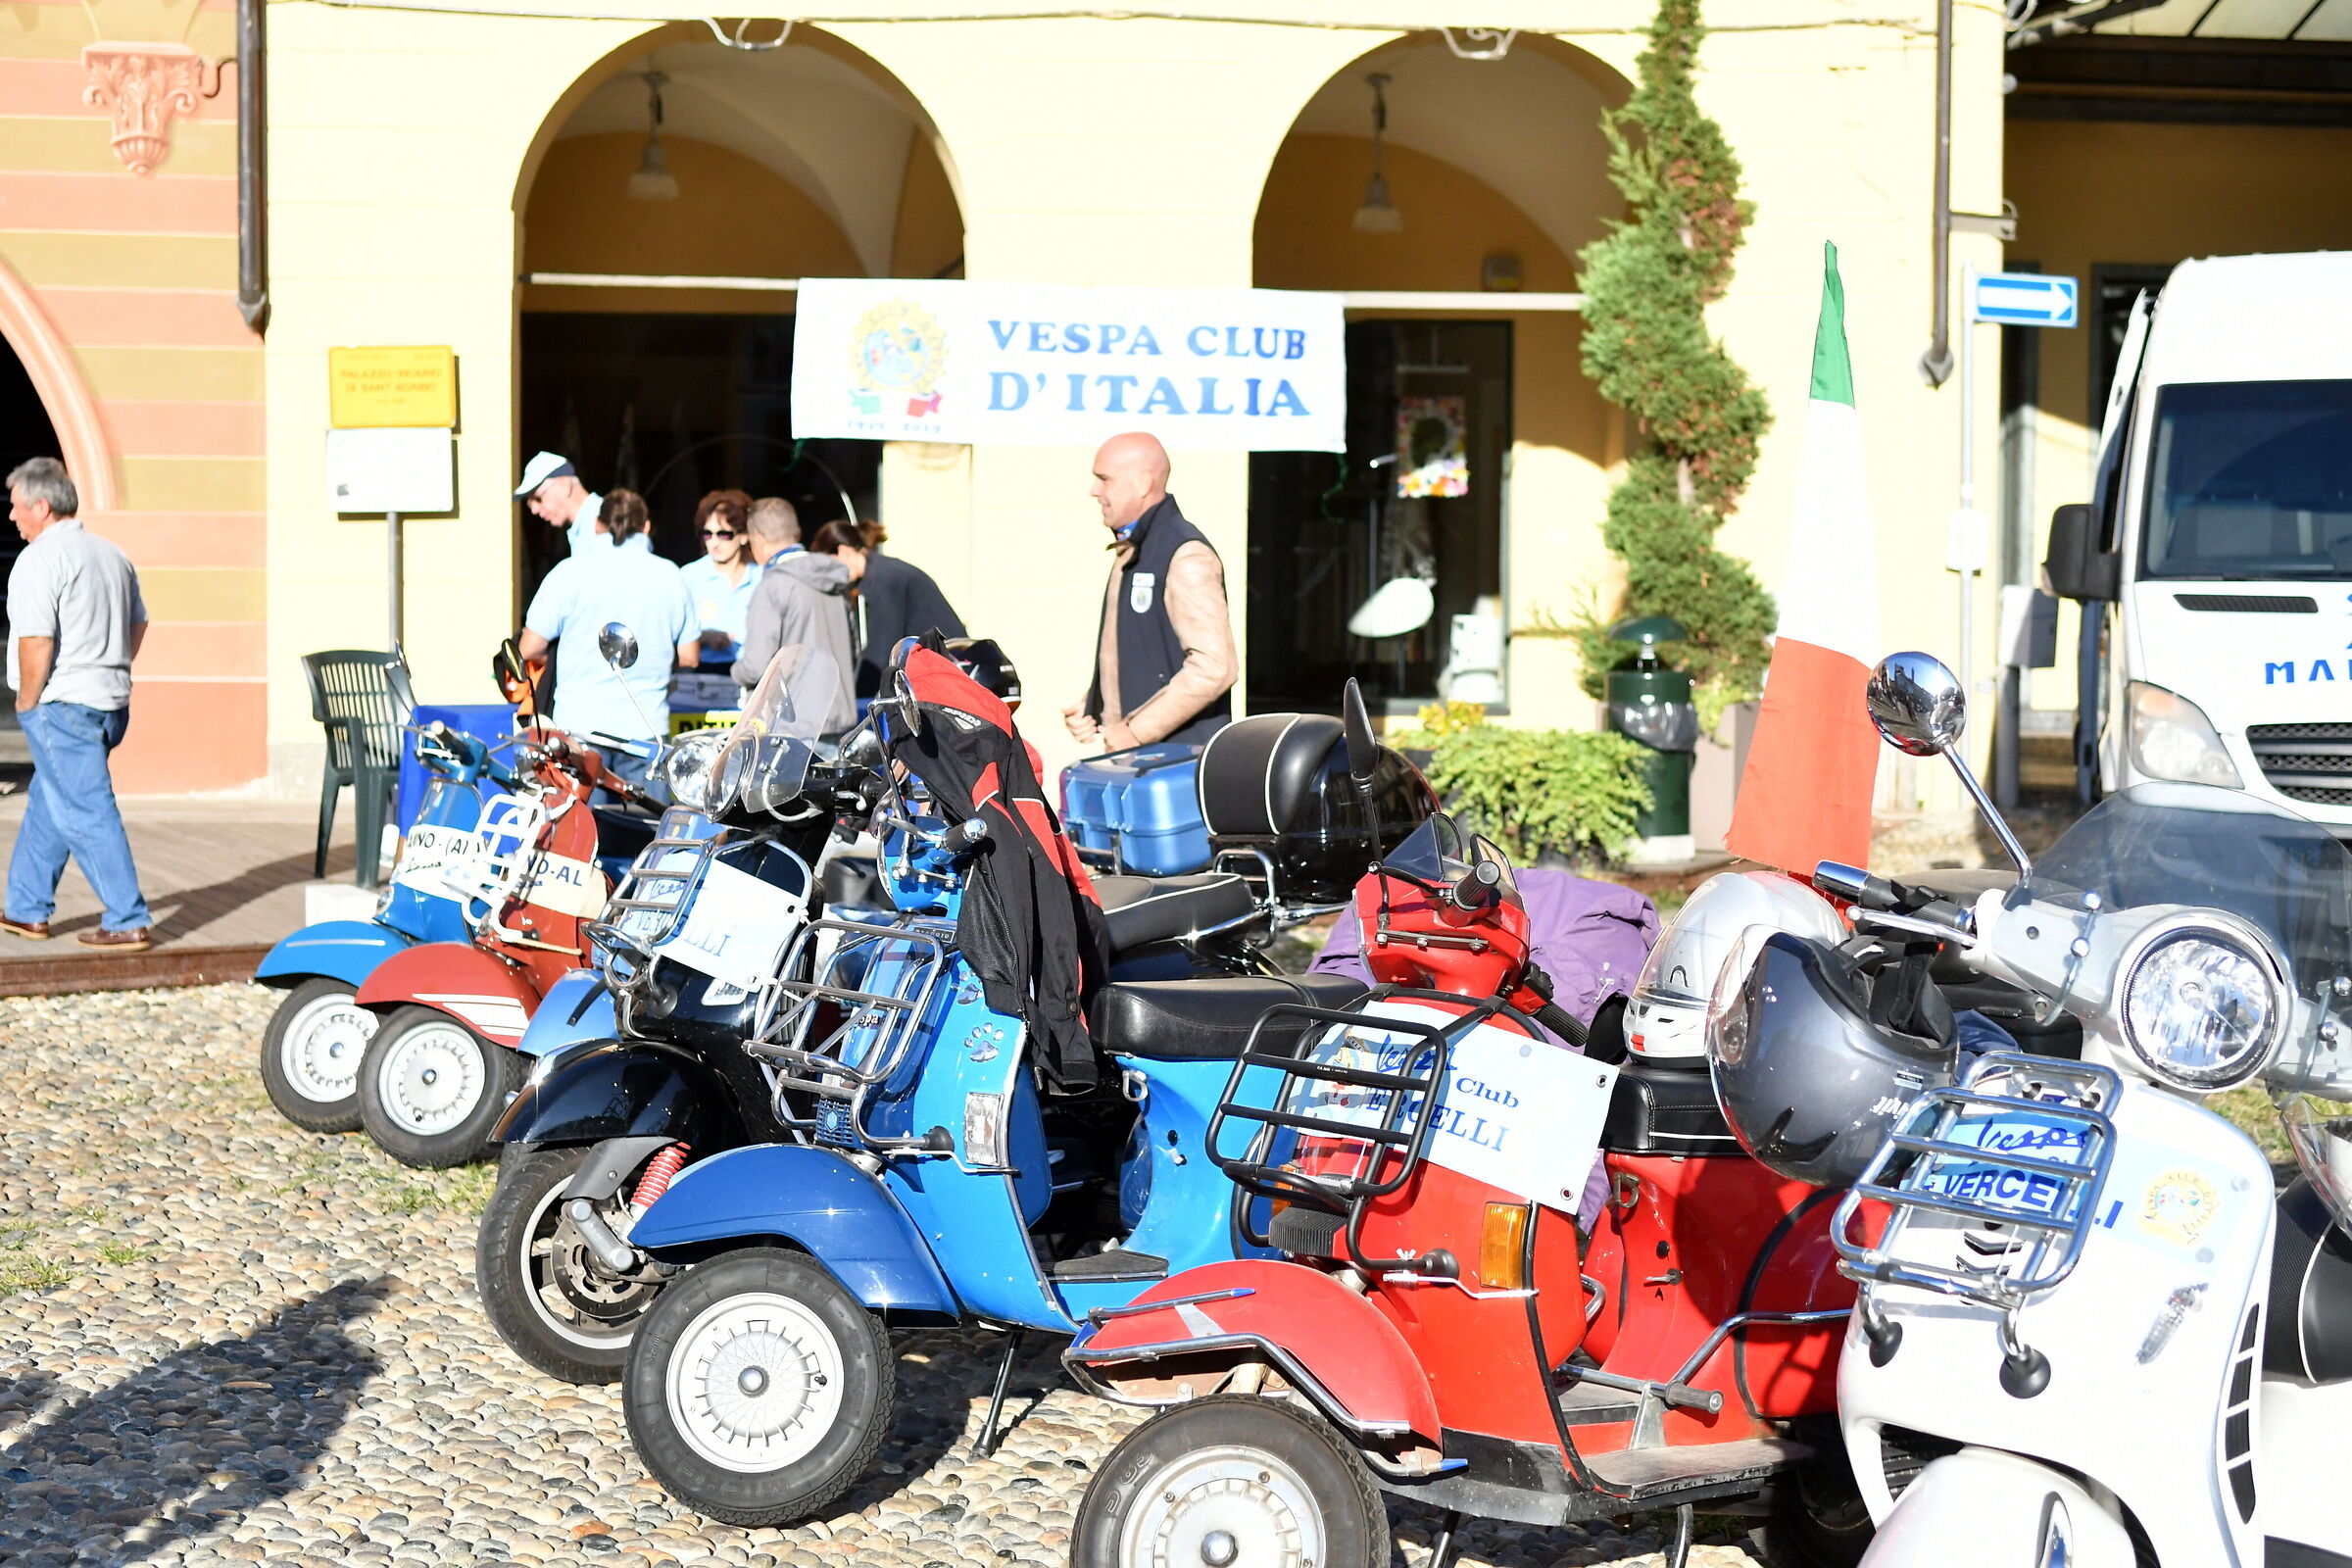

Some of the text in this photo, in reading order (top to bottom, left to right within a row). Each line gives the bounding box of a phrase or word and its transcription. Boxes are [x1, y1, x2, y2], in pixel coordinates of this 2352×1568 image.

[987, 319, 1306, 360] VESPA CLUB
[2265, 659, 2352, 684] MA
[1456, 1077, 1519, 1108] Club
[1943, 1169, 2125, 1229] VERCEI
